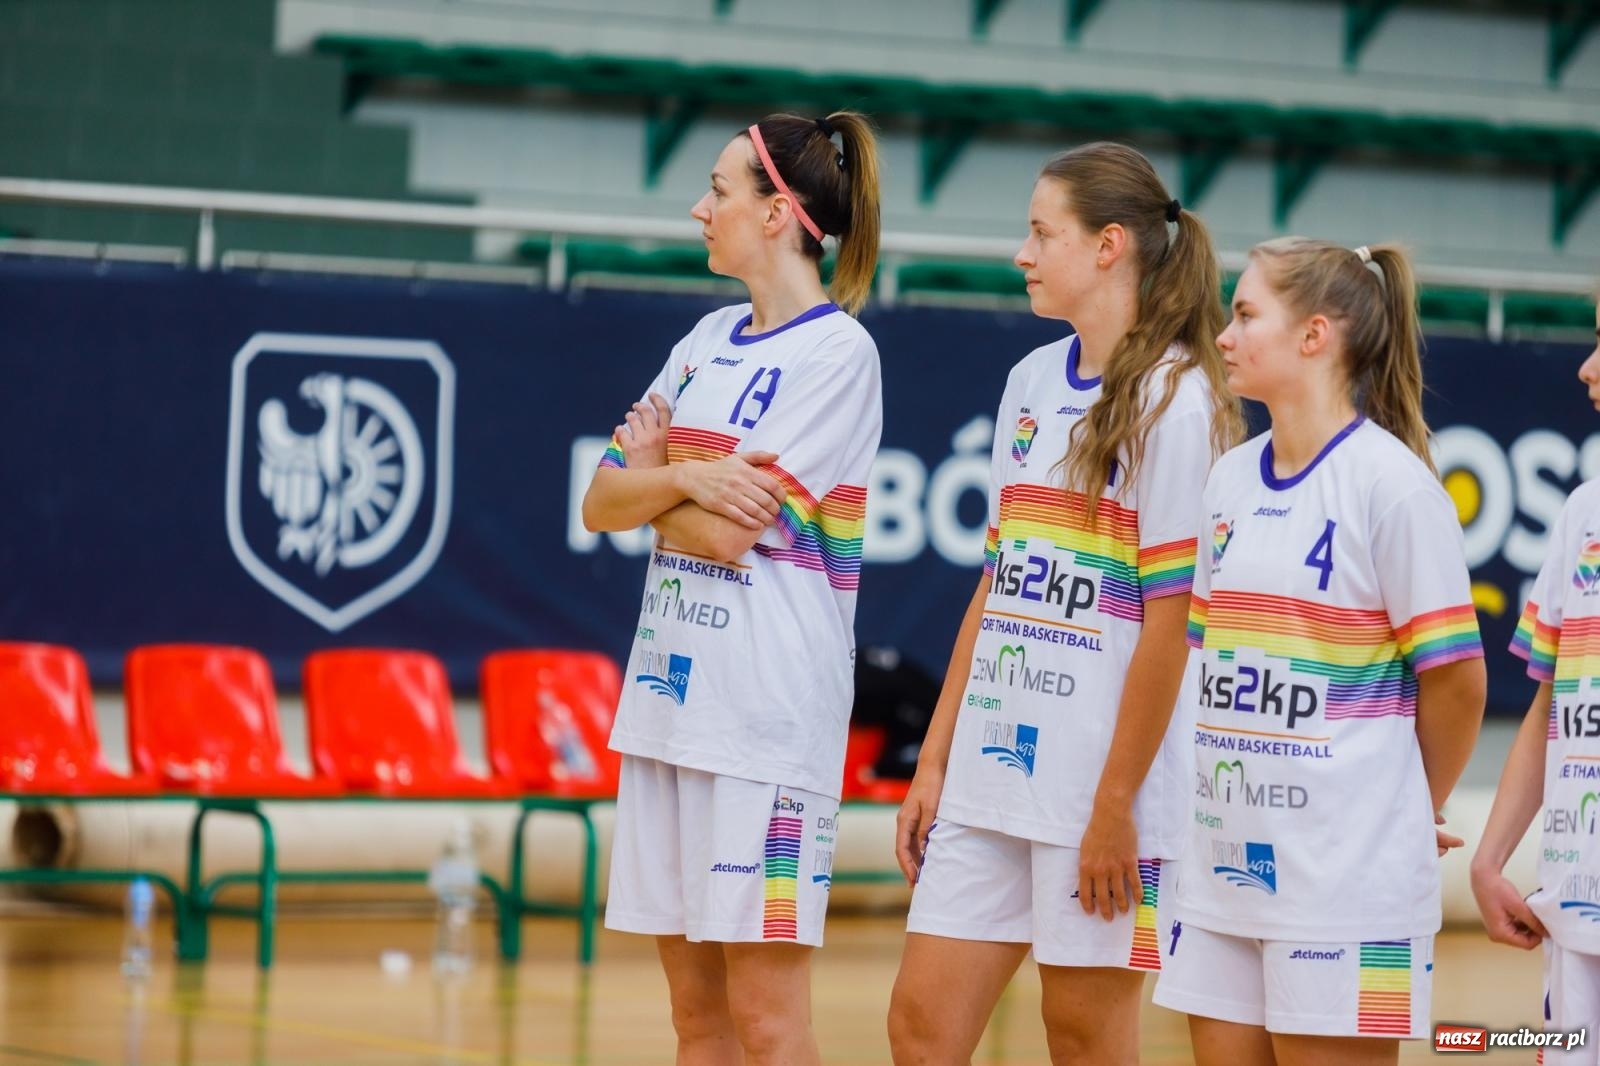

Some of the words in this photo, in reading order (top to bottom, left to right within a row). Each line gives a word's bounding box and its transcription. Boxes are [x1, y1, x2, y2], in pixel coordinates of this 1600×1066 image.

[728, 367, 782, 429] 13
[678, 558, 753, 586] BASKETBALL
[994, 551, 1095, 619] ks2kp
[1304, 519, 1337, 591] 4
[995, 619, 1021, 637] THAN
[1022, 624, 1103, 652] BASKETBALL
[1199, 662, 1318, 729] ks2kp
[1238, 738, 1334, 759] BASKETBALL
